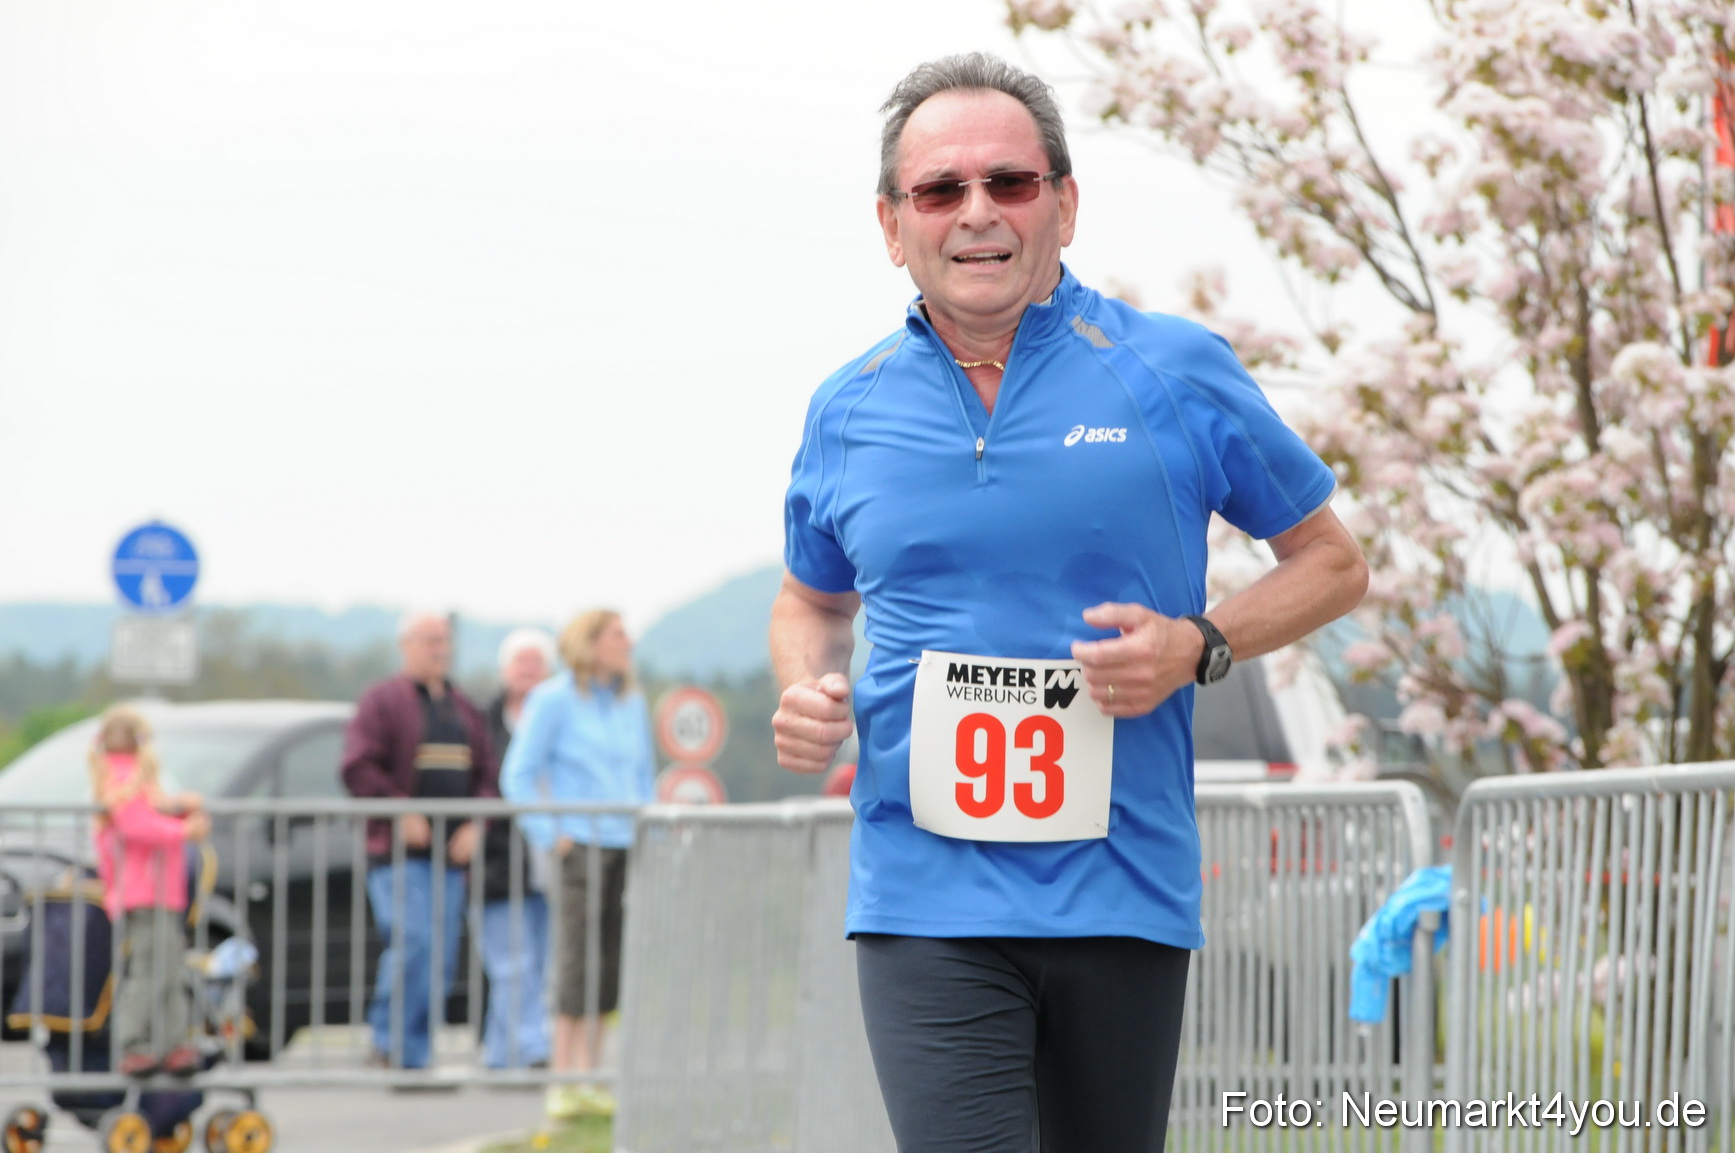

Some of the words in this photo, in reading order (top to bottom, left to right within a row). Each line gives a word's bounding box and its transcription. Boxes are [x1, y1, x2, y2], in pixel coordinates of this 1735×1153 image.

[1084, 427, 1127, 443] asics
[946, 662, 1036, 688] MEYER
[946, 685, 1037, 705] WERBUNG
[955, 712, 1065, 820] 93
